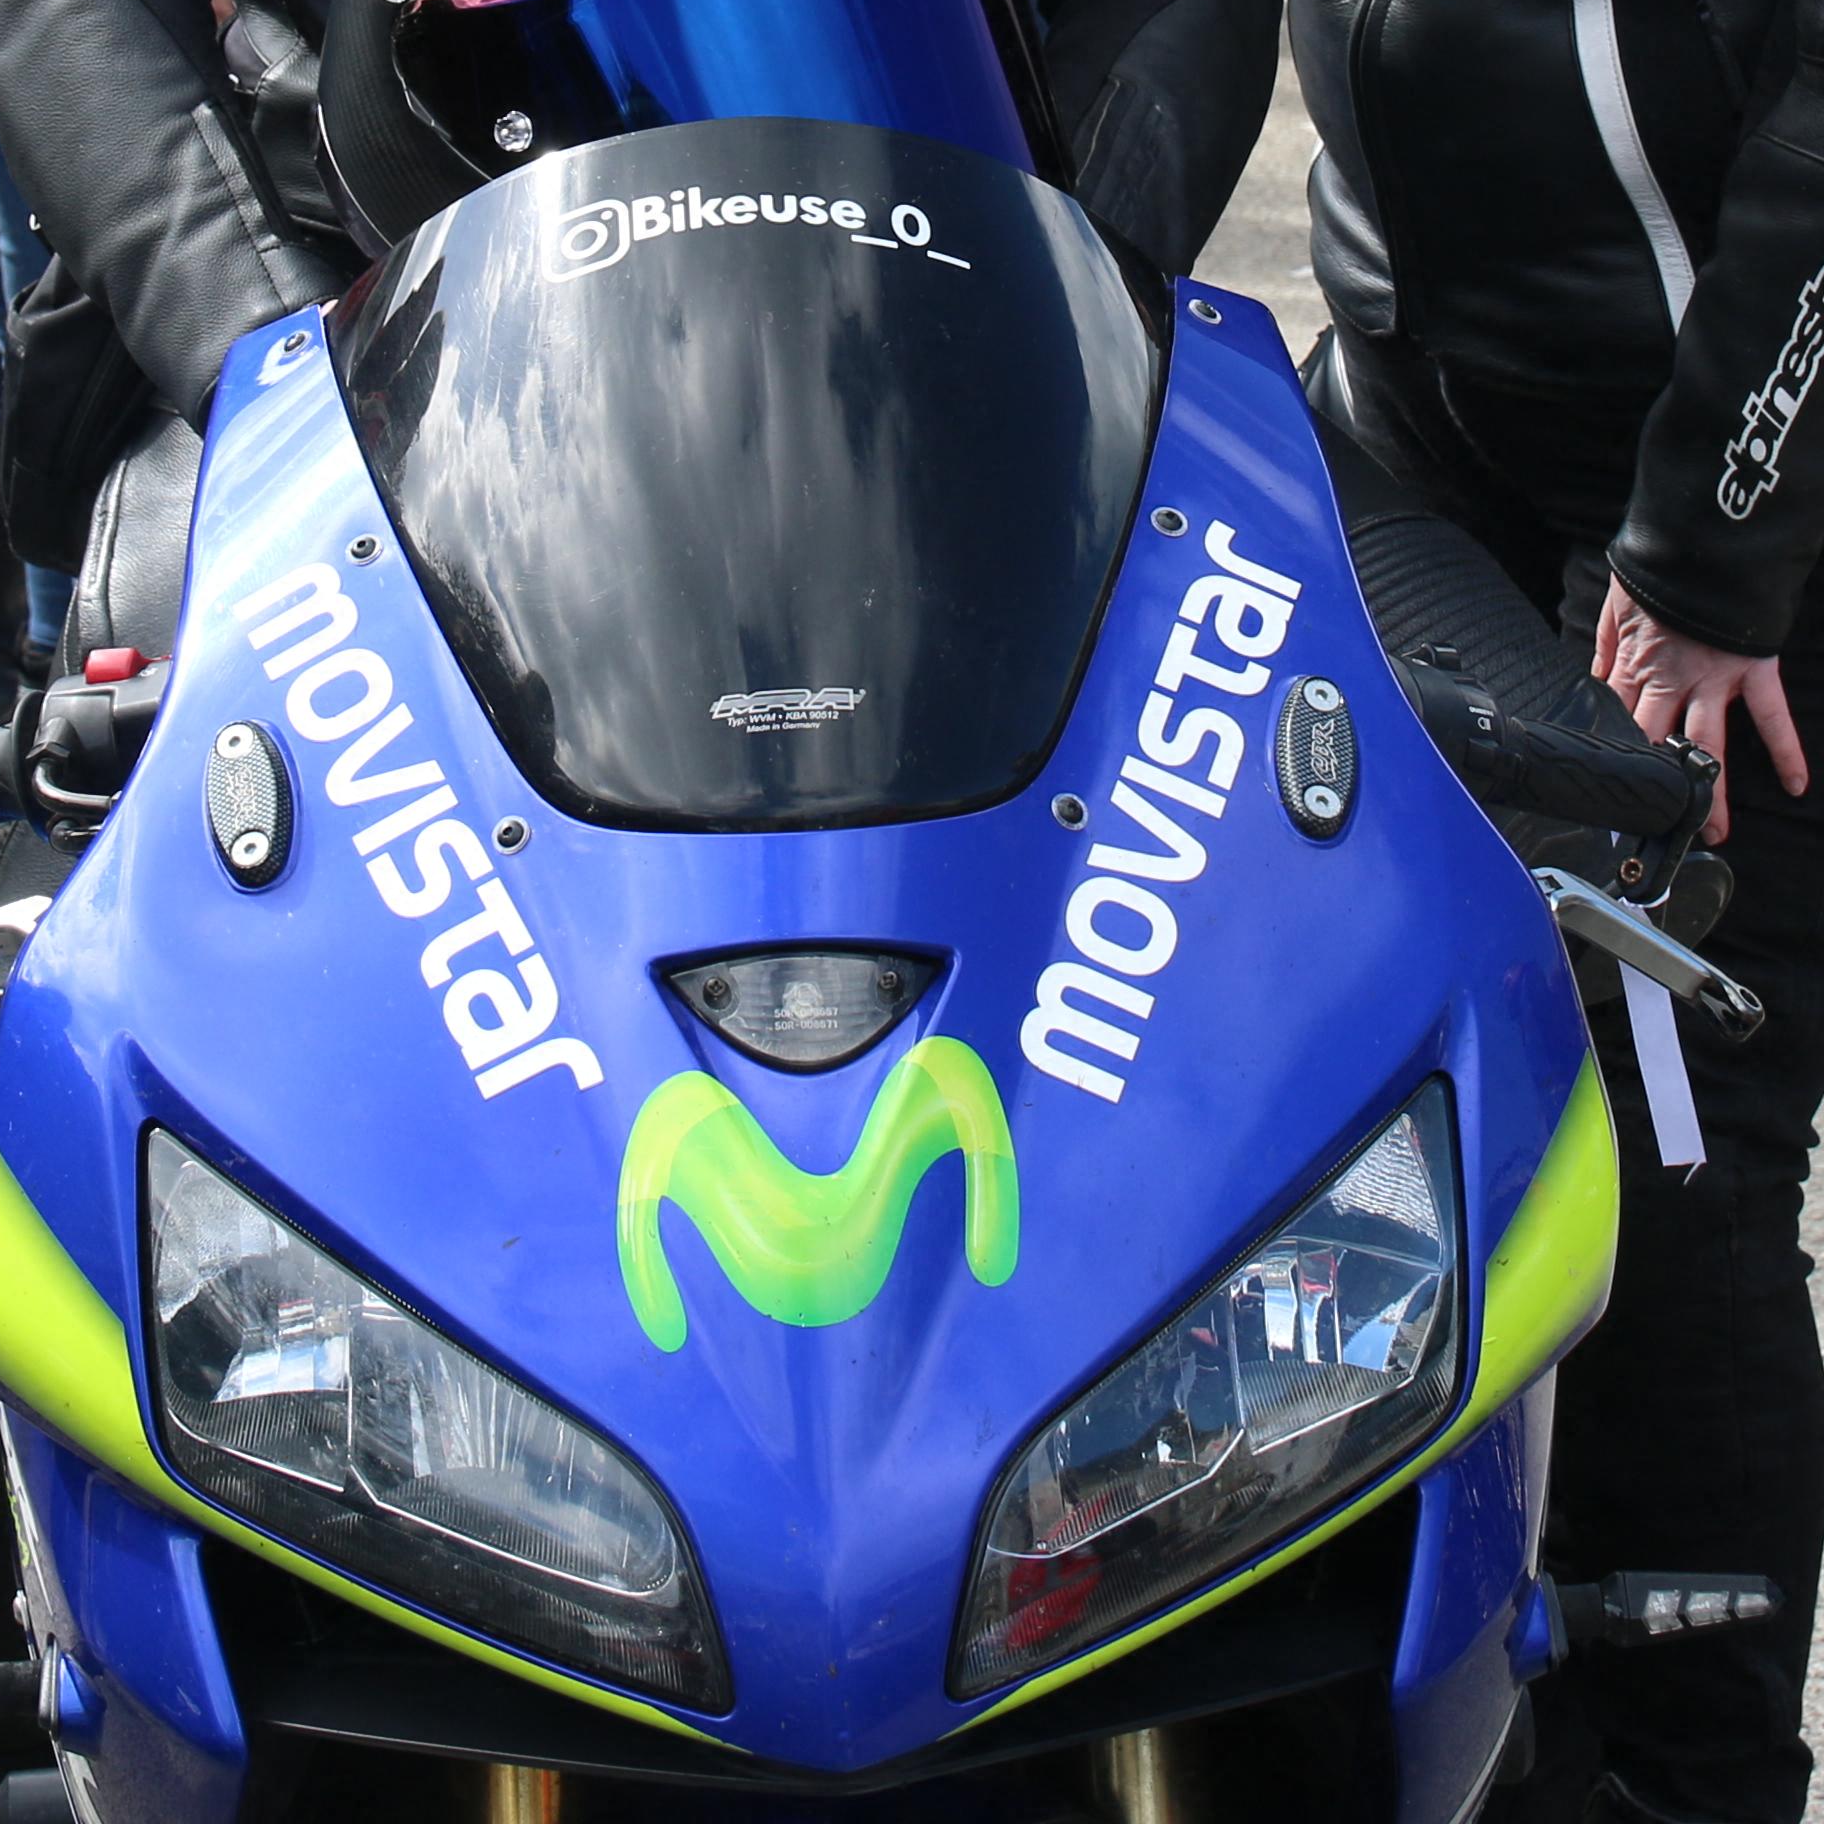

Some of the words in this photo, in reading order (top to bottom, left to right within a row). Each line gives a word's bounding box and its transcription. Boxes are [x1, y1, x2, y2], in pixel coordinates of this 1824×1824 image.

[231, 561, 606, 1101] movistar
[785, 709, 808, 721] KBA
[1018, 518, 1303, 1104] movistar
